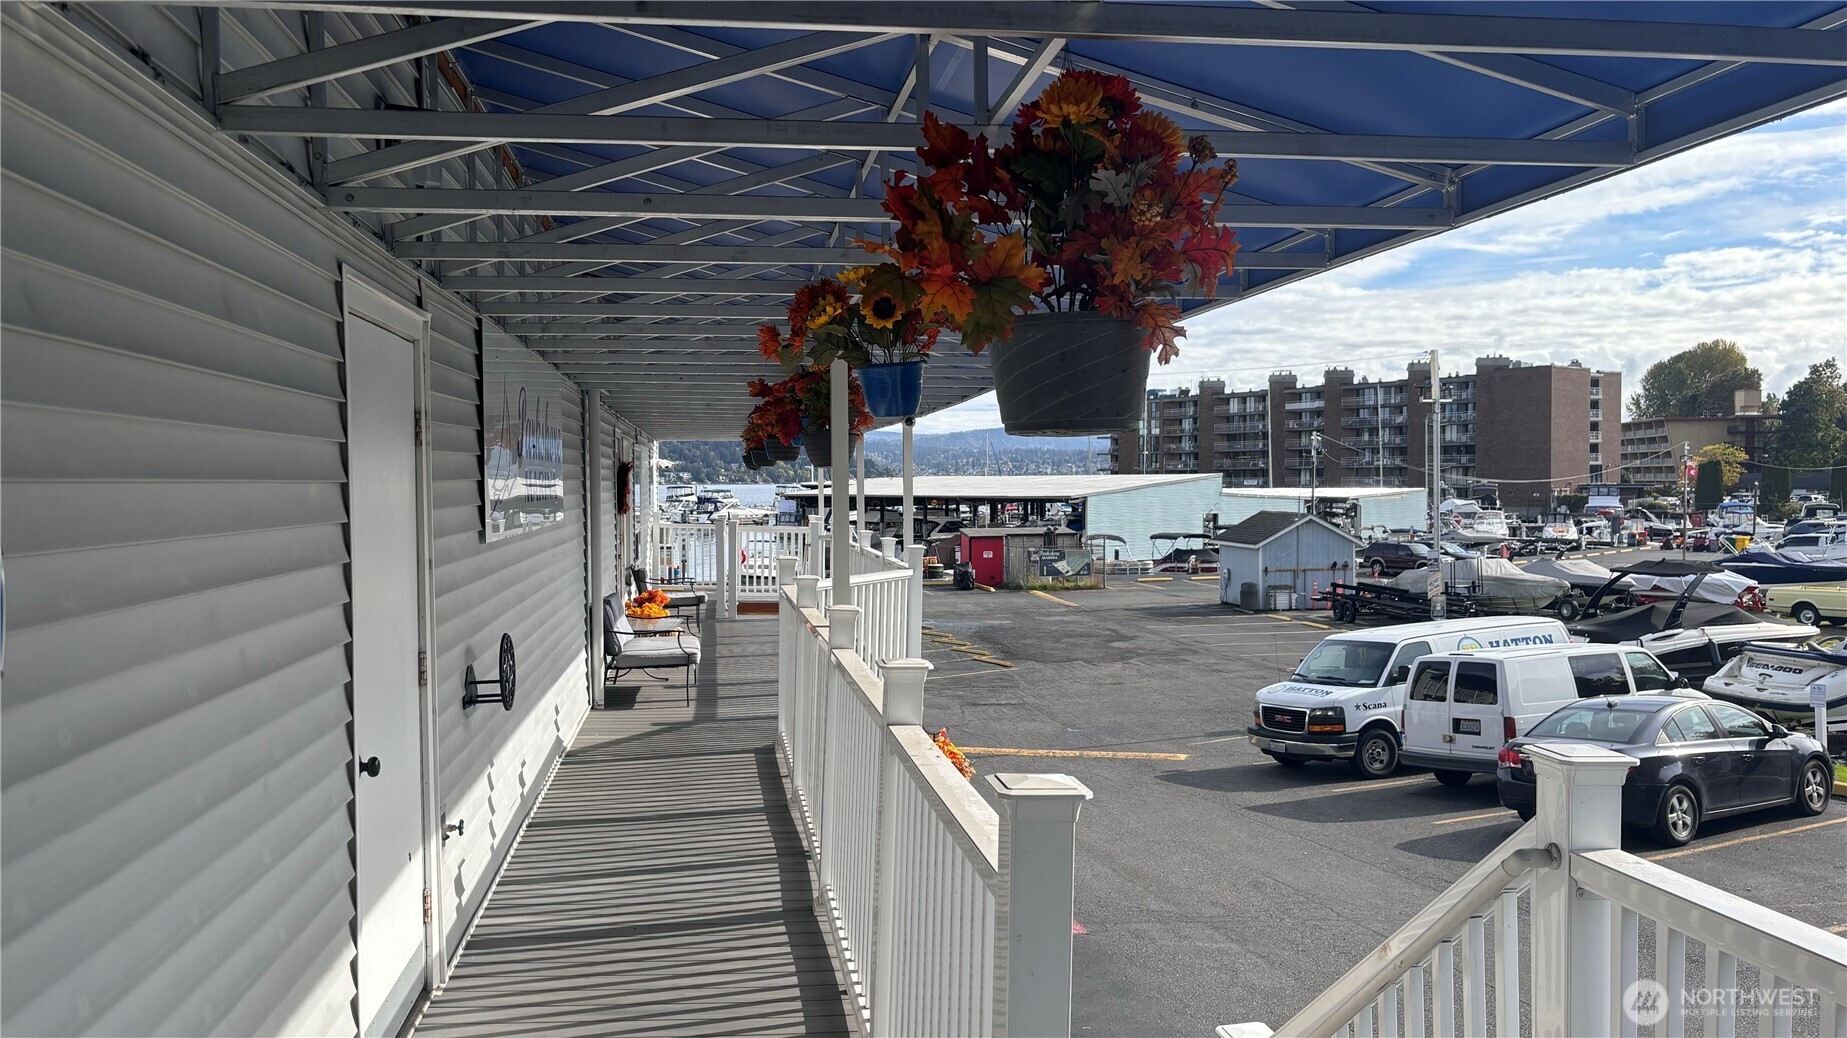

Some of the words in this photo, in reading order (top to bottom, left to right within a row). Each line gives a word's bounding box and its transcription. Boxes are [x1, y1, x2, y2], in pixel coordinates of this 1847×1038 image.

[1488, 633, 1554, 648] HATTON
[1285, 686, 1334, 696] HATTON
[1362, 701, 1388, 711] Scana
[1274, 714, 1292, 723] GMC
